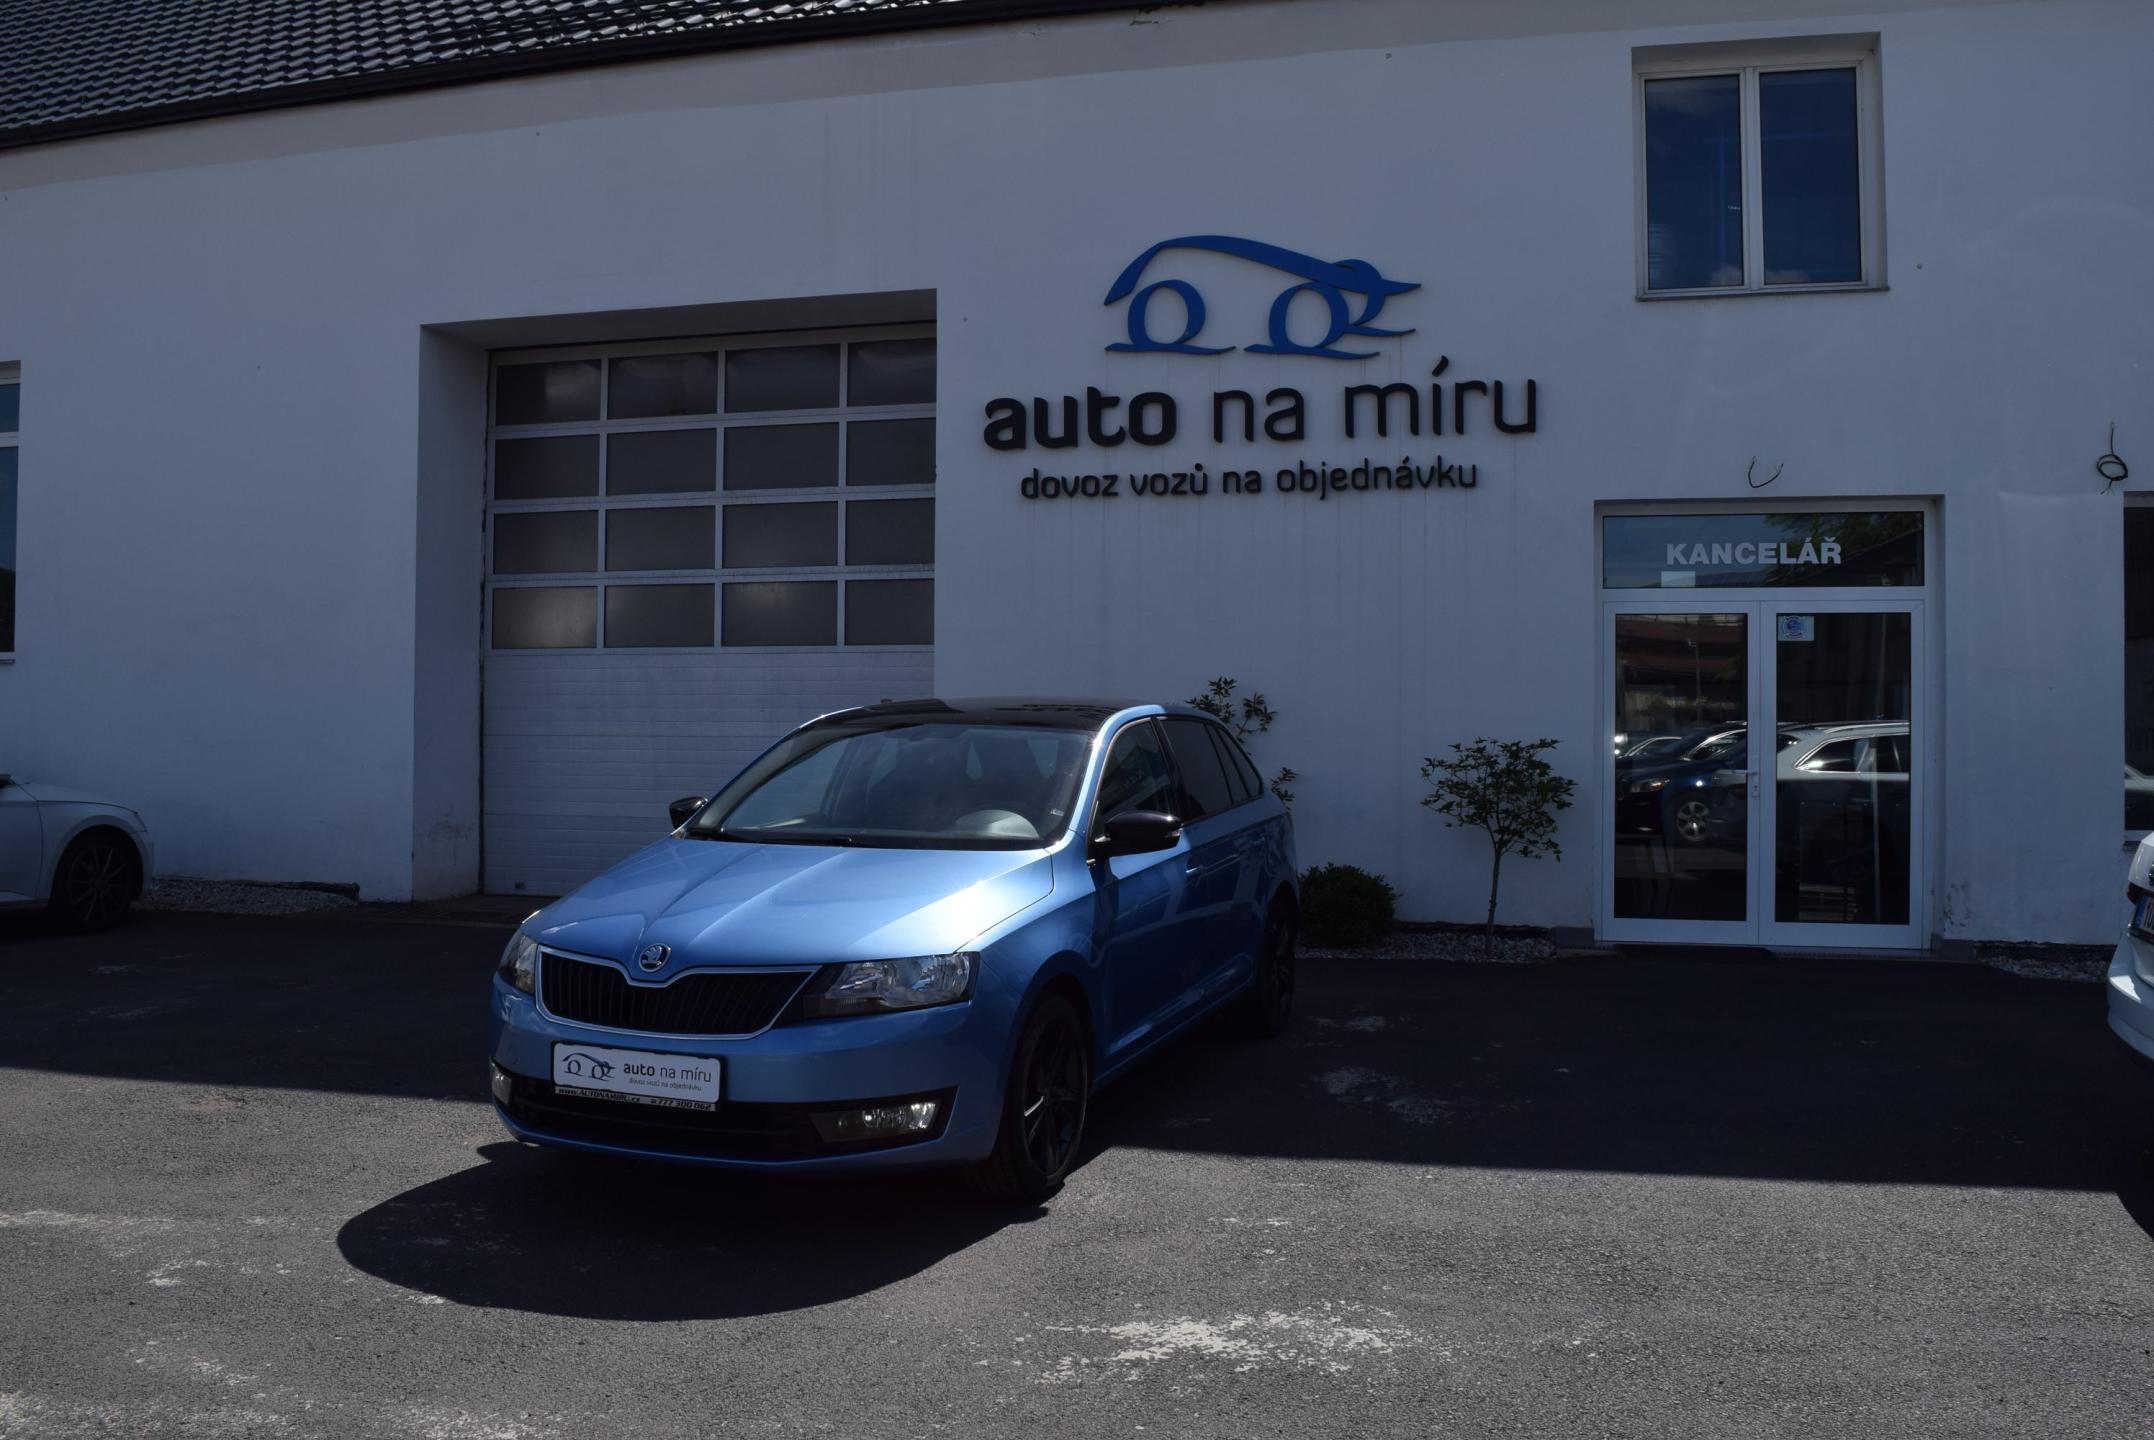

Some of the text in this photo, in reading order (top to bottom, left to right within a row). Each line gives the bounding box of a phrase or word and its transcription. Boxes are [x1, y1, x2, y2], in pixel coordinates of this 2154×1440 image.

[983, 355, 1537, 450] auto na míru
[1020, 455, 1477, 500] dovoz vozů na objednávku
[1666, 536, 1842, 565] KANCELÁŘ
[623, 1063, 711, 1082] auto na míru
[659, 1098, 674, 1106] 777
